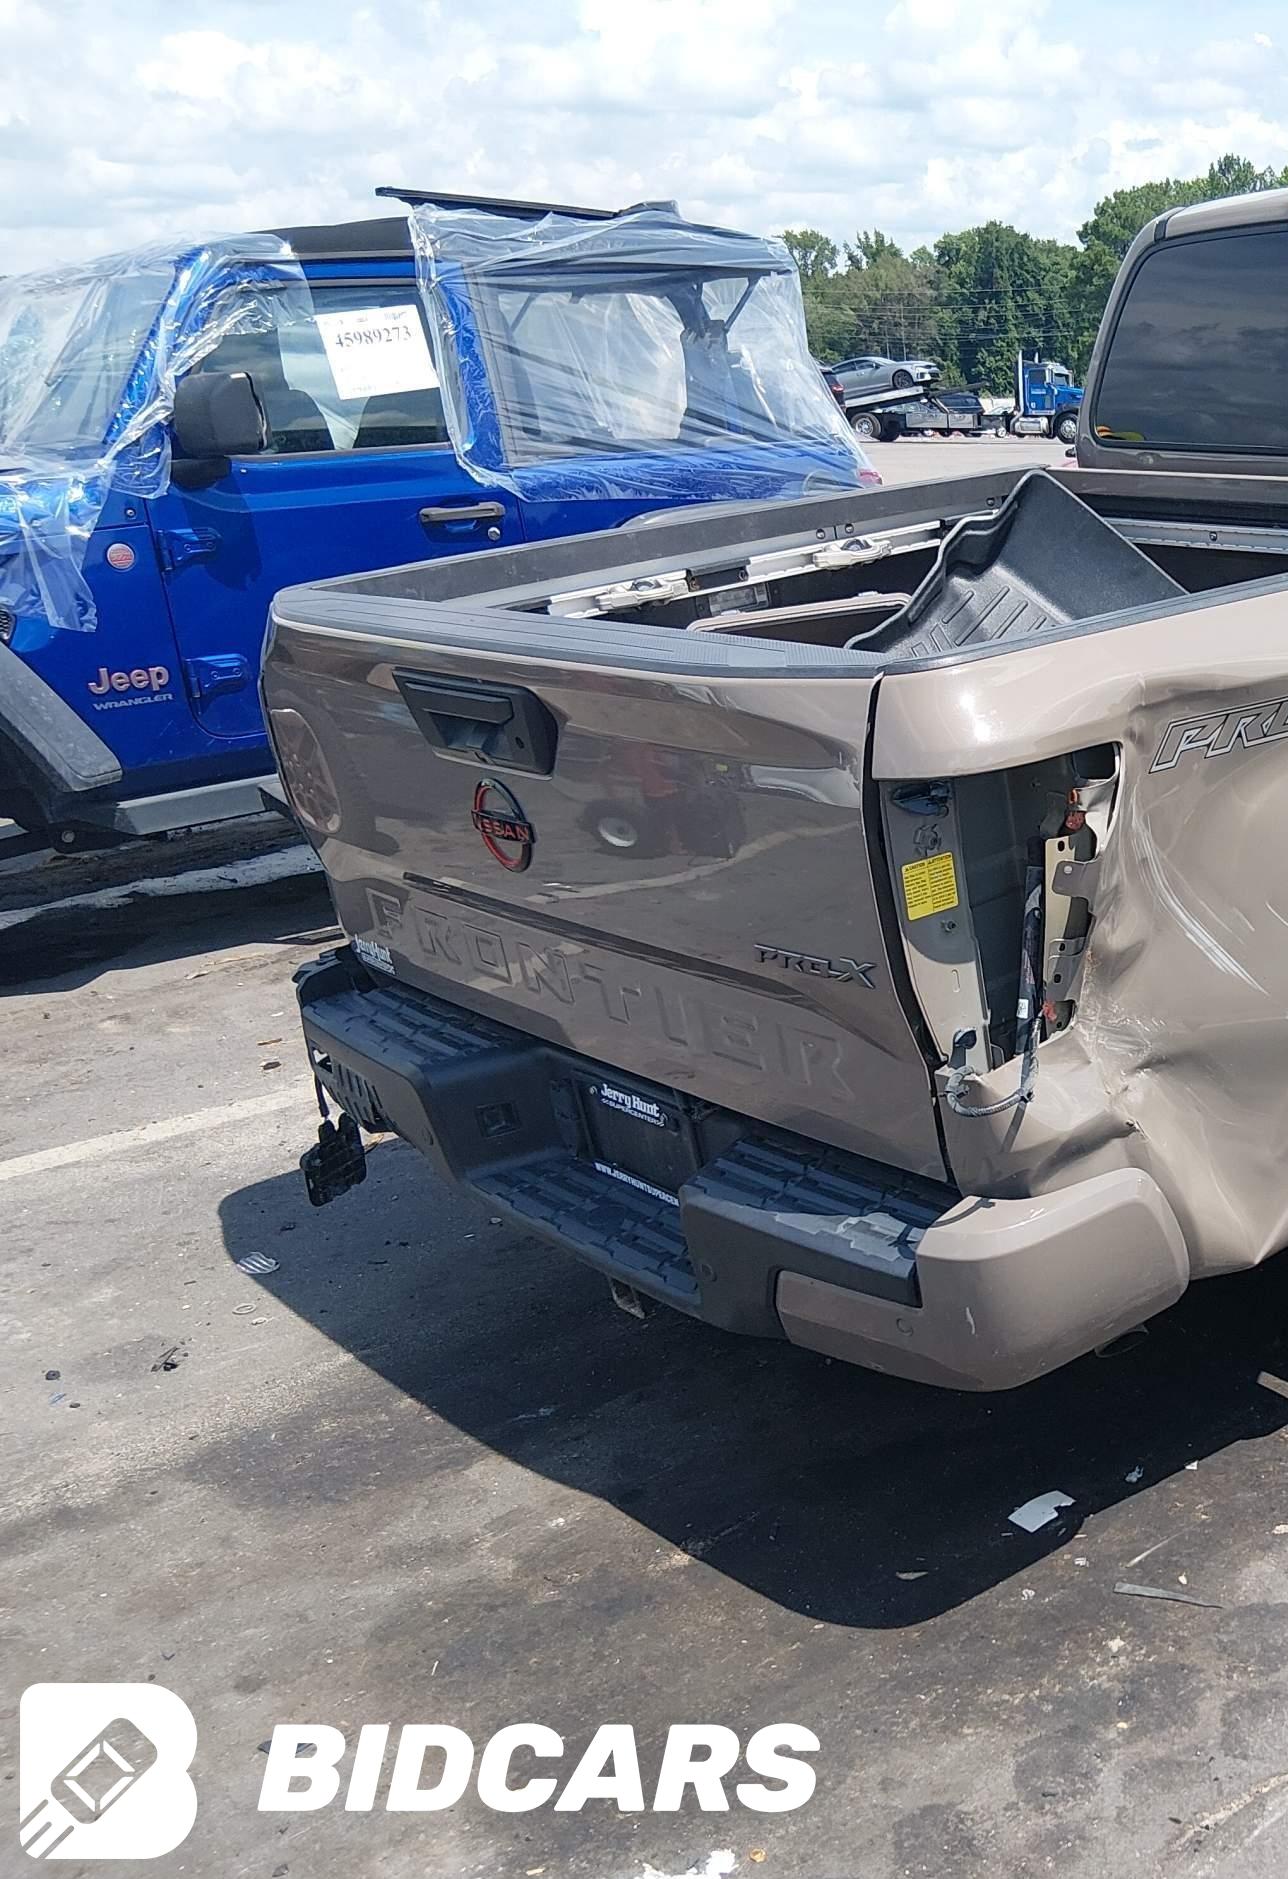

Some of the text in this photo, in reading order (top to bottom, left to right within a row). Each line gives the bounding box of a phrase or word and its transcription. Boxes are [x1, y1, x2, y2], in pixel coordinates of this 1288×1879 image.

[335, 325, 412, 348] 45989273
[88, 666, 169, 694] Jeep
[92, 693, 174, 711] WRANGLER
[365, 886, 854, 1102] FRONTIER
[601, 1083, 660, 1118] Jerry Hunt
